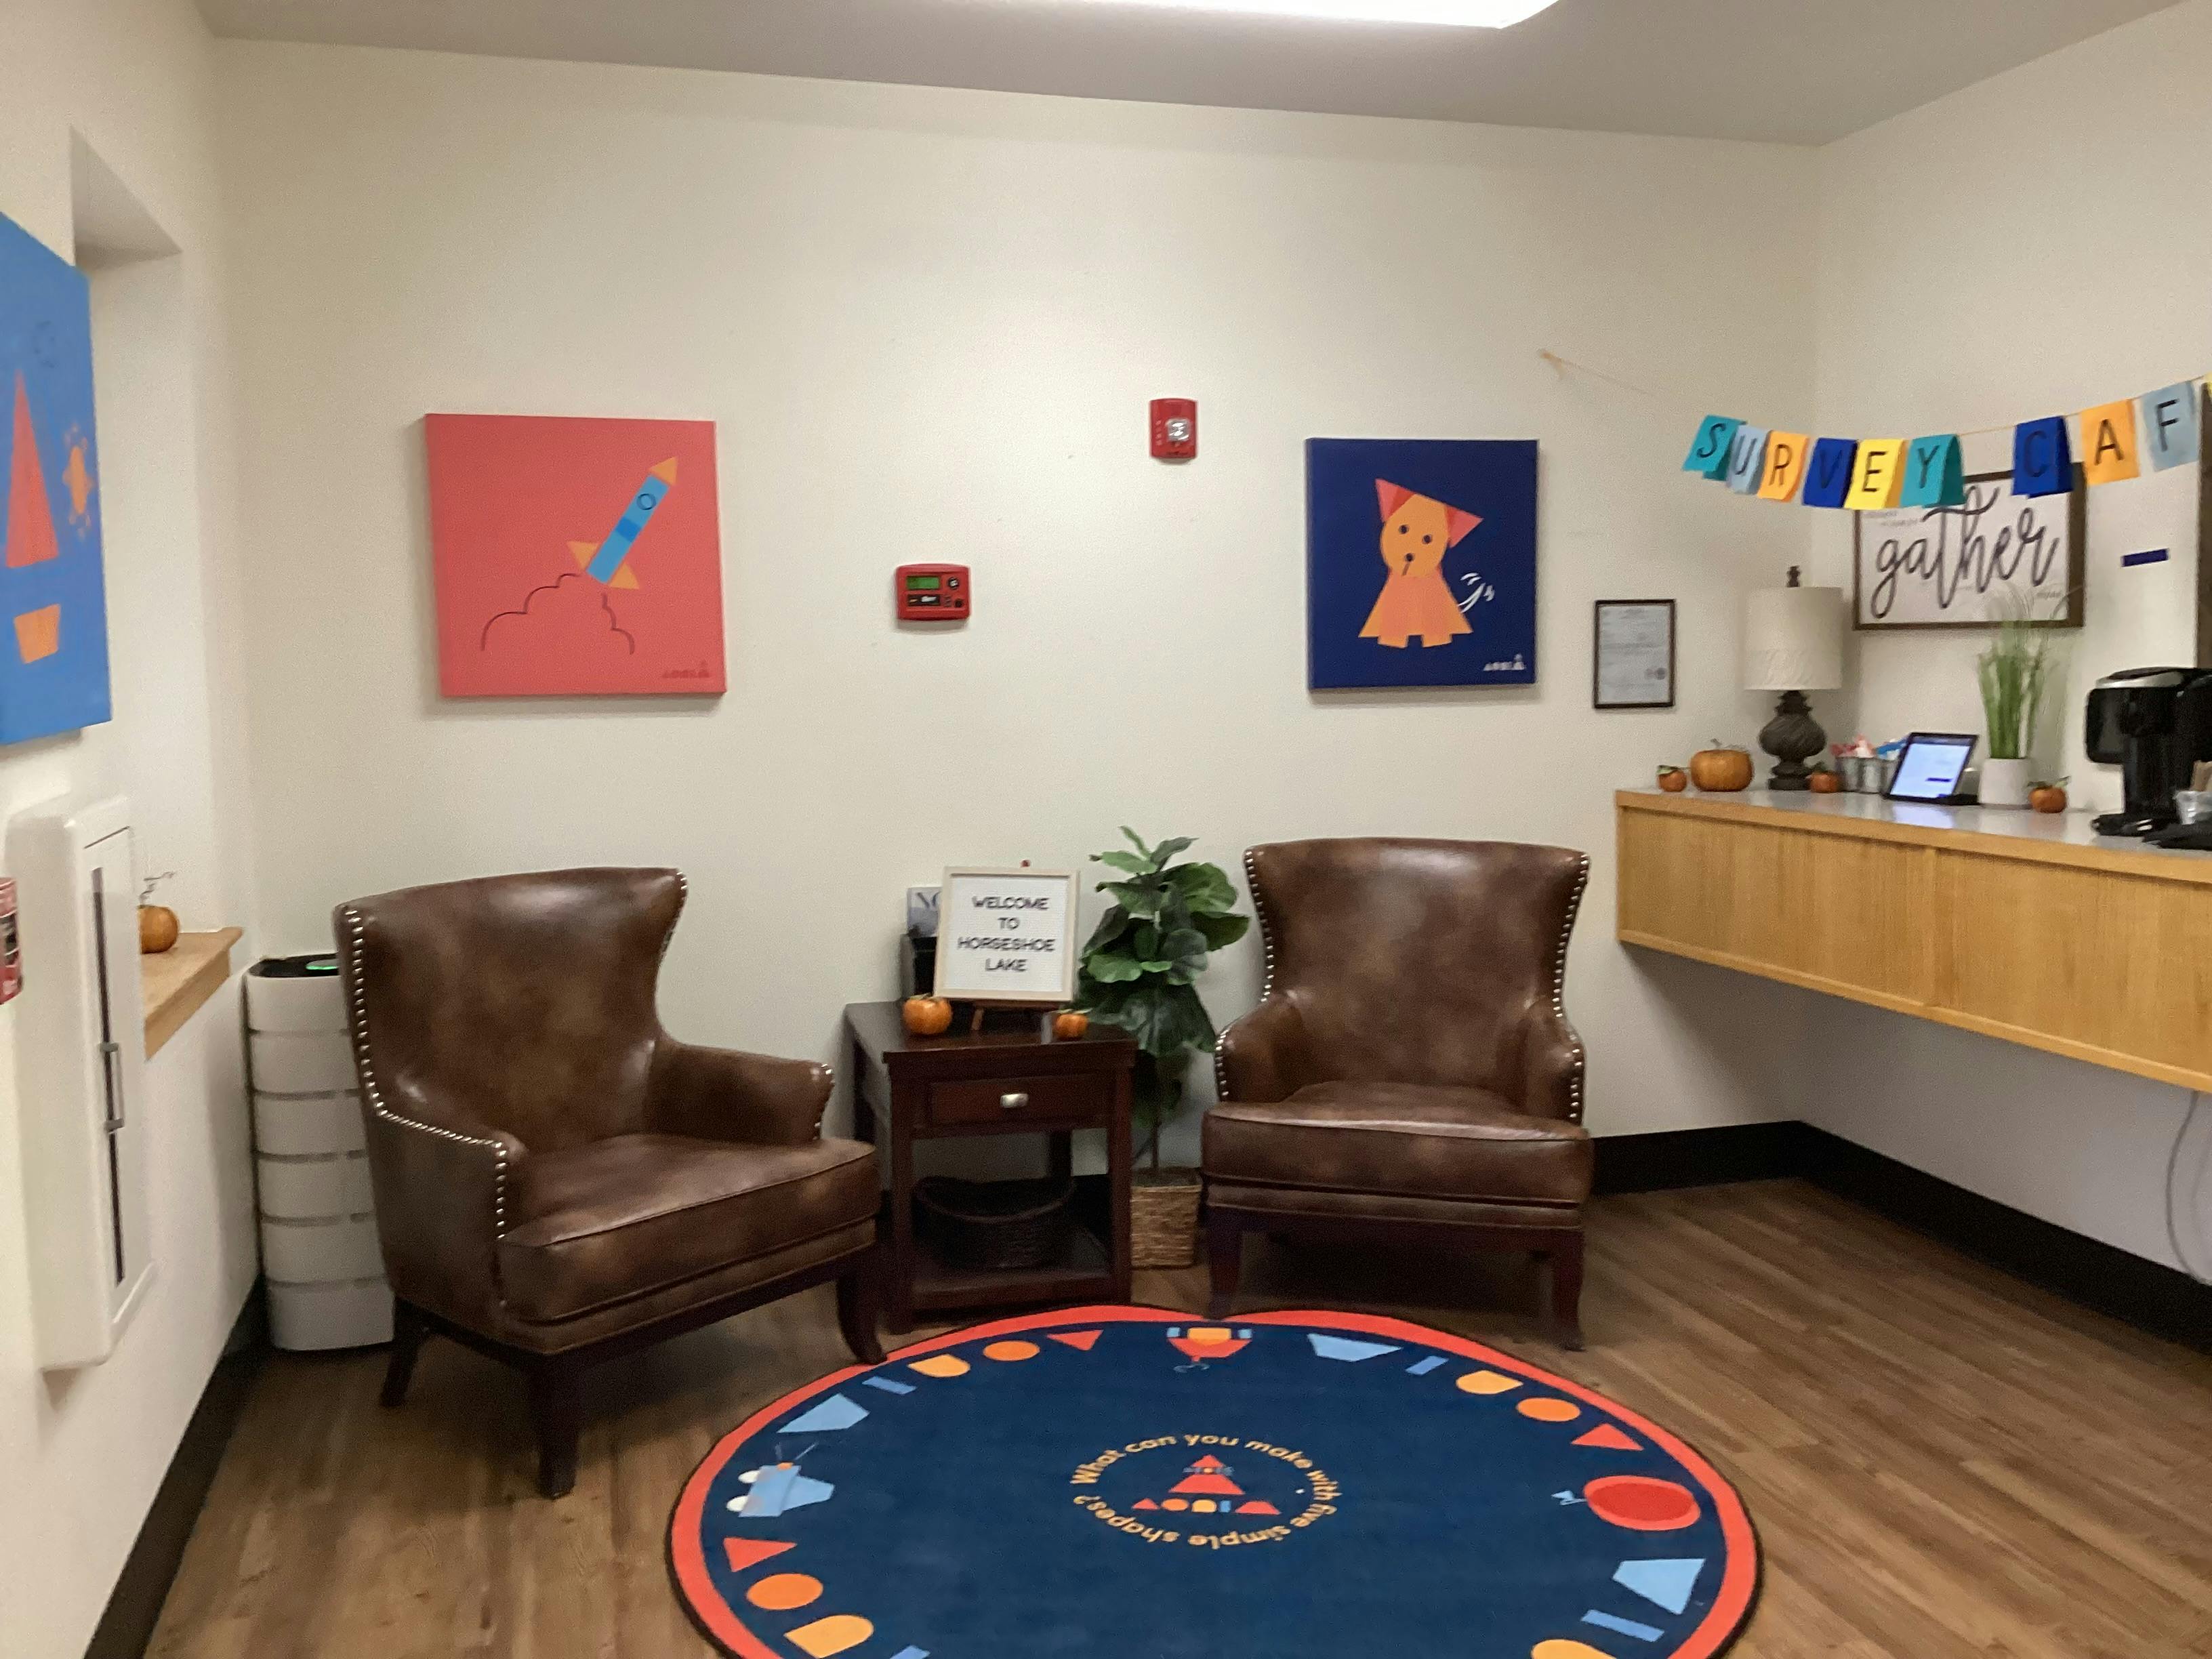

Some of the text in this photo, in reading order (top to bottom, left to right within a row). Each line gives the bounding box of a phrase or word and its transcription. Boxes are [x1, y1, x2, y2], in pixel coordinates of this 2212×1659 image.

[1698, 398, 2179, 493] SURVEY CAF
[1871, 485, 2060, 619] gather
[971, 896, 1050, 911] WELCOME
[998, 917, 1020, 930] TO
[957, 936, 1056, 952] HORSESHOE
[985, 958, 1028, 972] LAKE
[1071, 1434, 1343, 1550] What can you make with five simple shapes?
